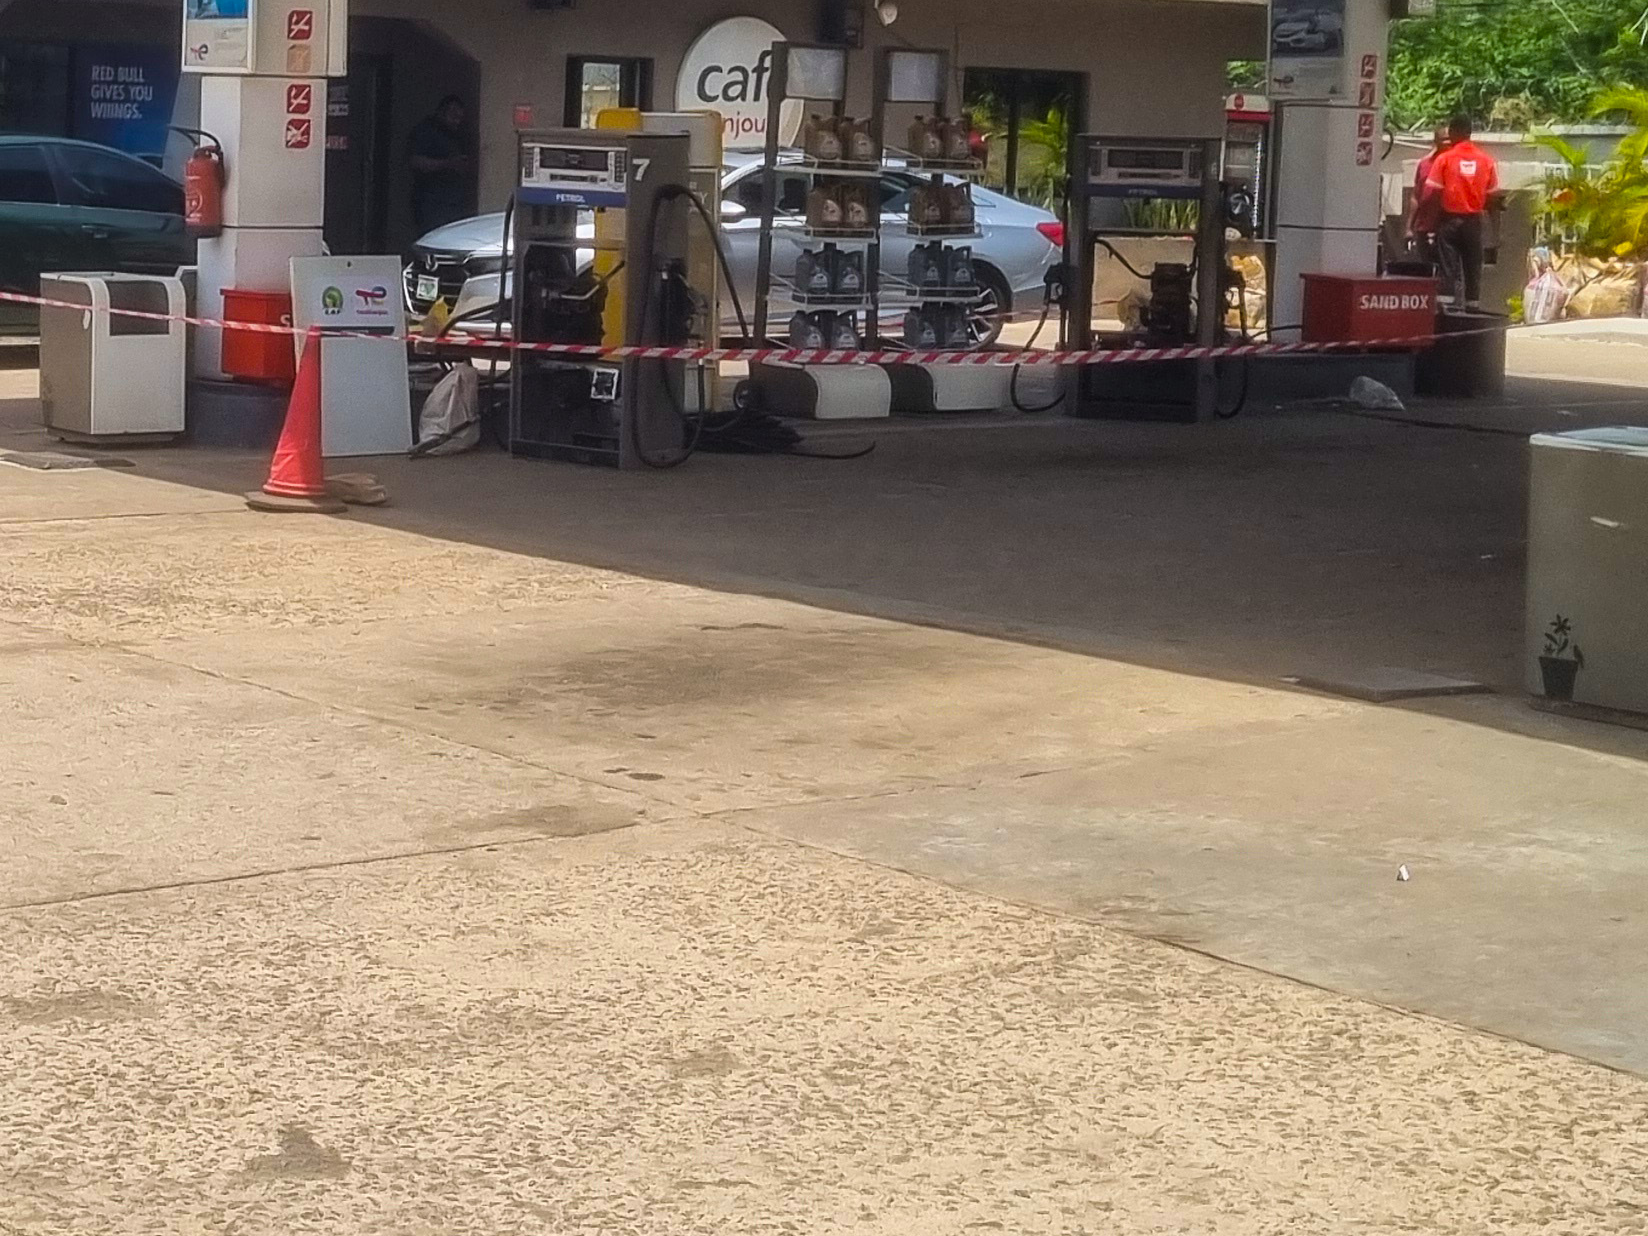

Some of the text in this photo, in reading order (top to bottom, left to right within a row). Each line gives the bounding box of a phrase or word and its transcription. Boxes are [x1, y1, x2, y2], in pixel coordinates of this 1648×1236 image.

[92, 65, 145, 82] RED BULL
[696, 49, 772, 103] caf
[91, 84, 154, 101] GIVES YOU
[632, 158, 650, 181] 7
[1360, 294, 1429, 310] SAND BOX
